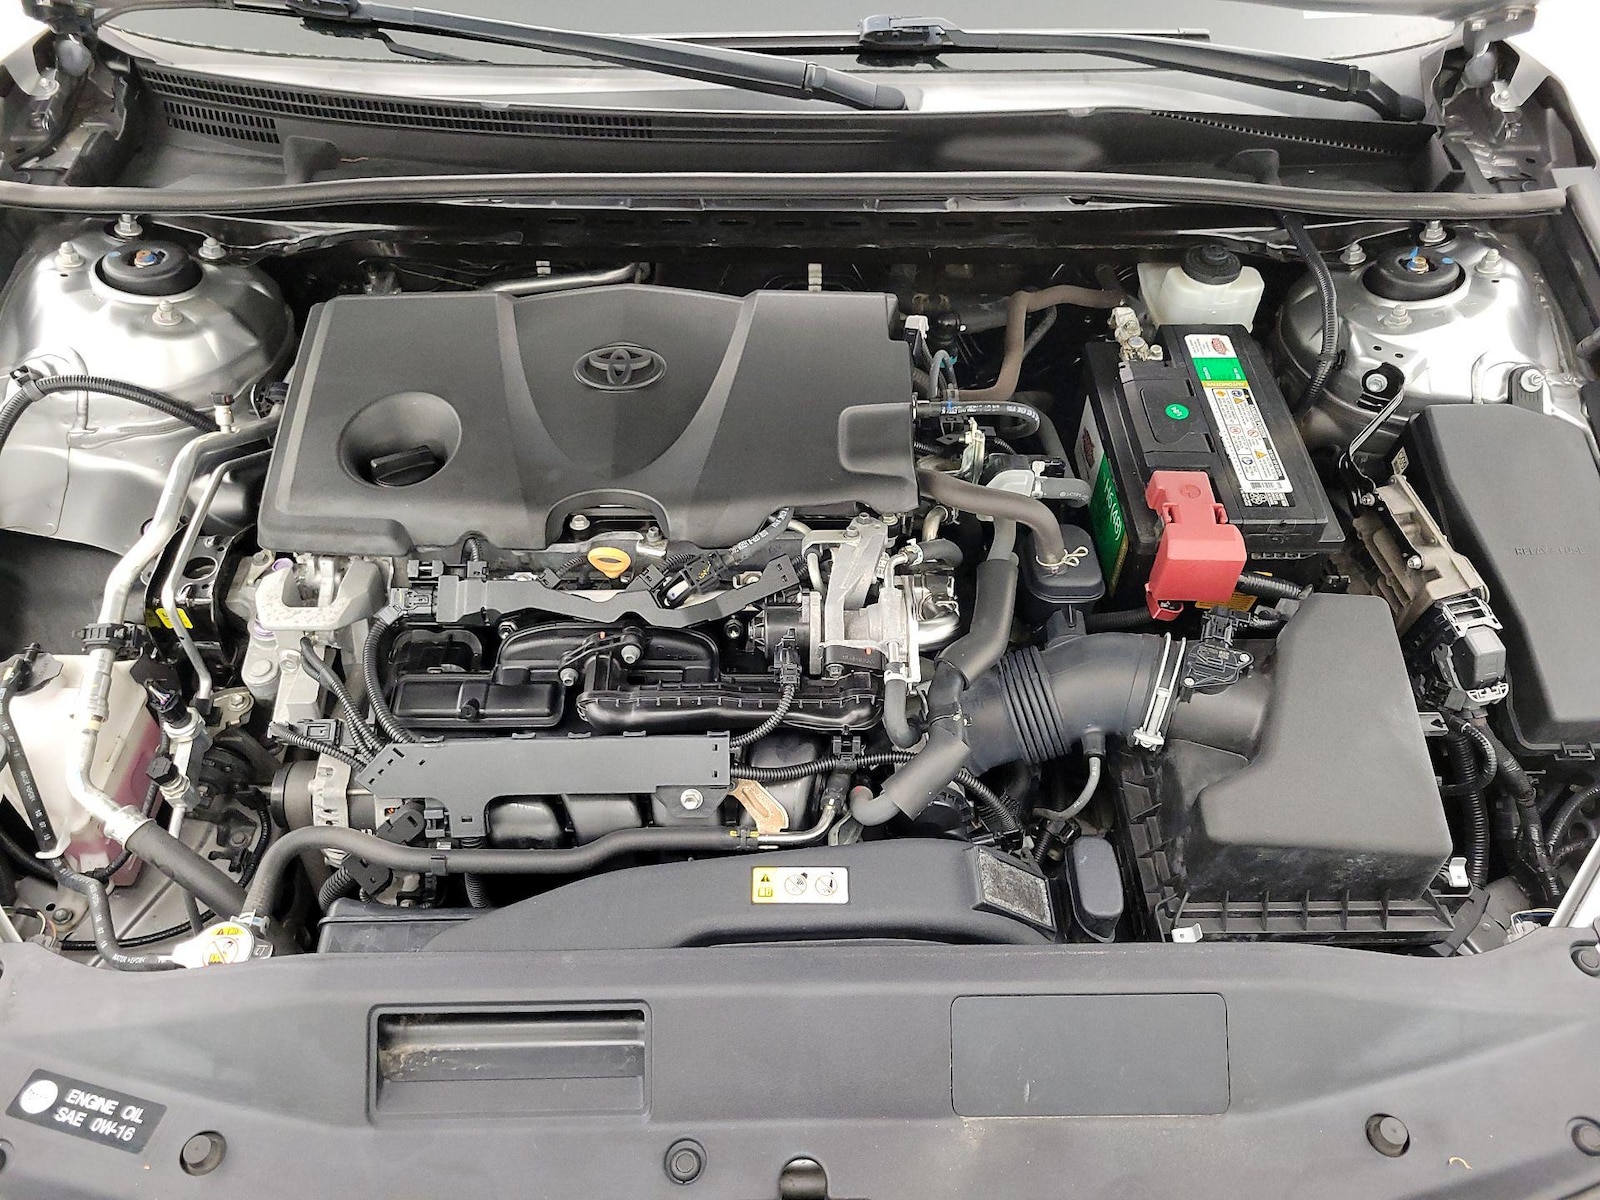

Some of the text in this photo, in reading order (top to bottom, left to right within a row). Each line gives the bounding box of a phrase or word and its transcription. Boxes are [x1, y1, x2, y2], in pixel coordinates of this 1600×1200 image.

[1104, 478, 1122, 541] H6(48)
[54, 1107, 137, 1142] SAE 0W-16
[66, 1088, 120, 1116] ENGINE
[121, 1105, 145, 1125] OIL
